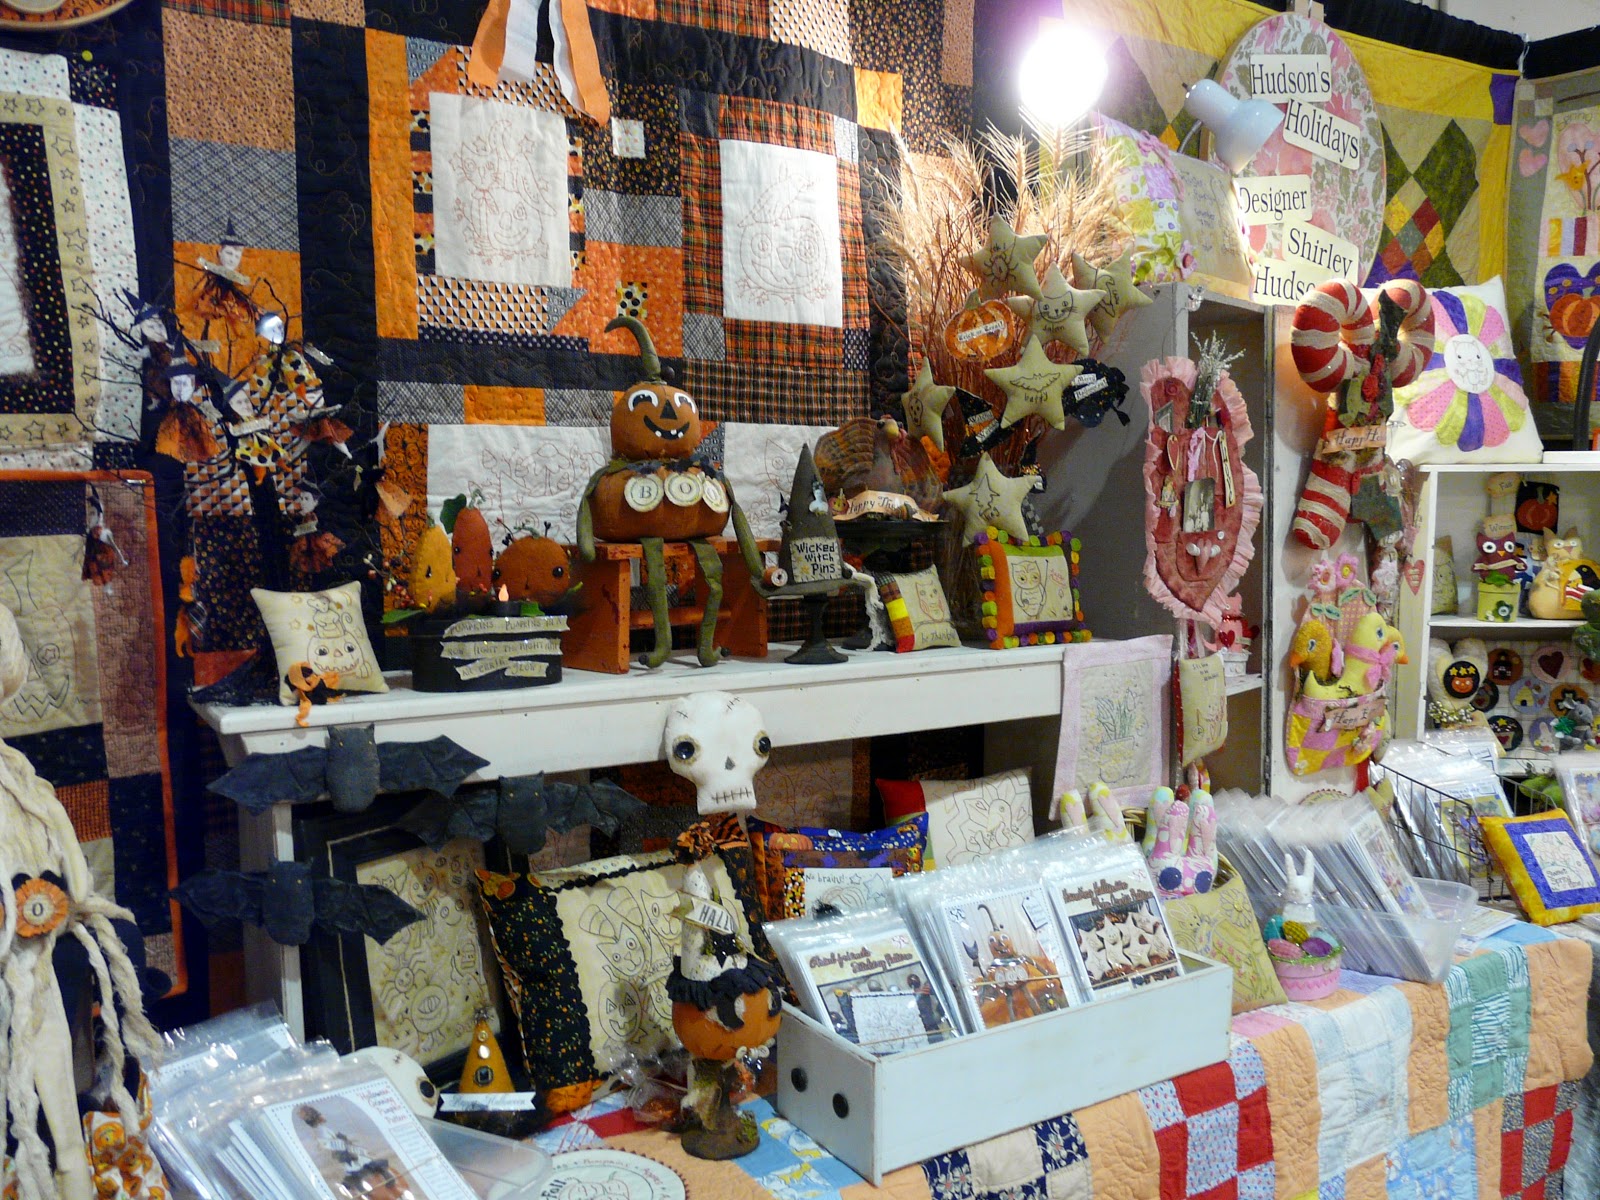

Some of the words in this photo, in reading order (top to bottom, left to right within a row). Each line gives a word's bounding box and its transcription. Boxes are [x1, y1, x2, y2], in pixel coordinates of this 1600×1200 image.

[1251, 62, 1331, 95] Hudson's
[1285, 99, 1359, 163] Holidays
[1239, 186, 1308, 220] Designer
[1287, 227, 1353, 278] Shirley
[1254, 264, 1316, 302] Hudso
[795, 542, 835, 553] Wicked
[805, 552, 834, 562] Witch
[812, 562, 835, 575] Pins
[699, 904, 733, 931] HALL
